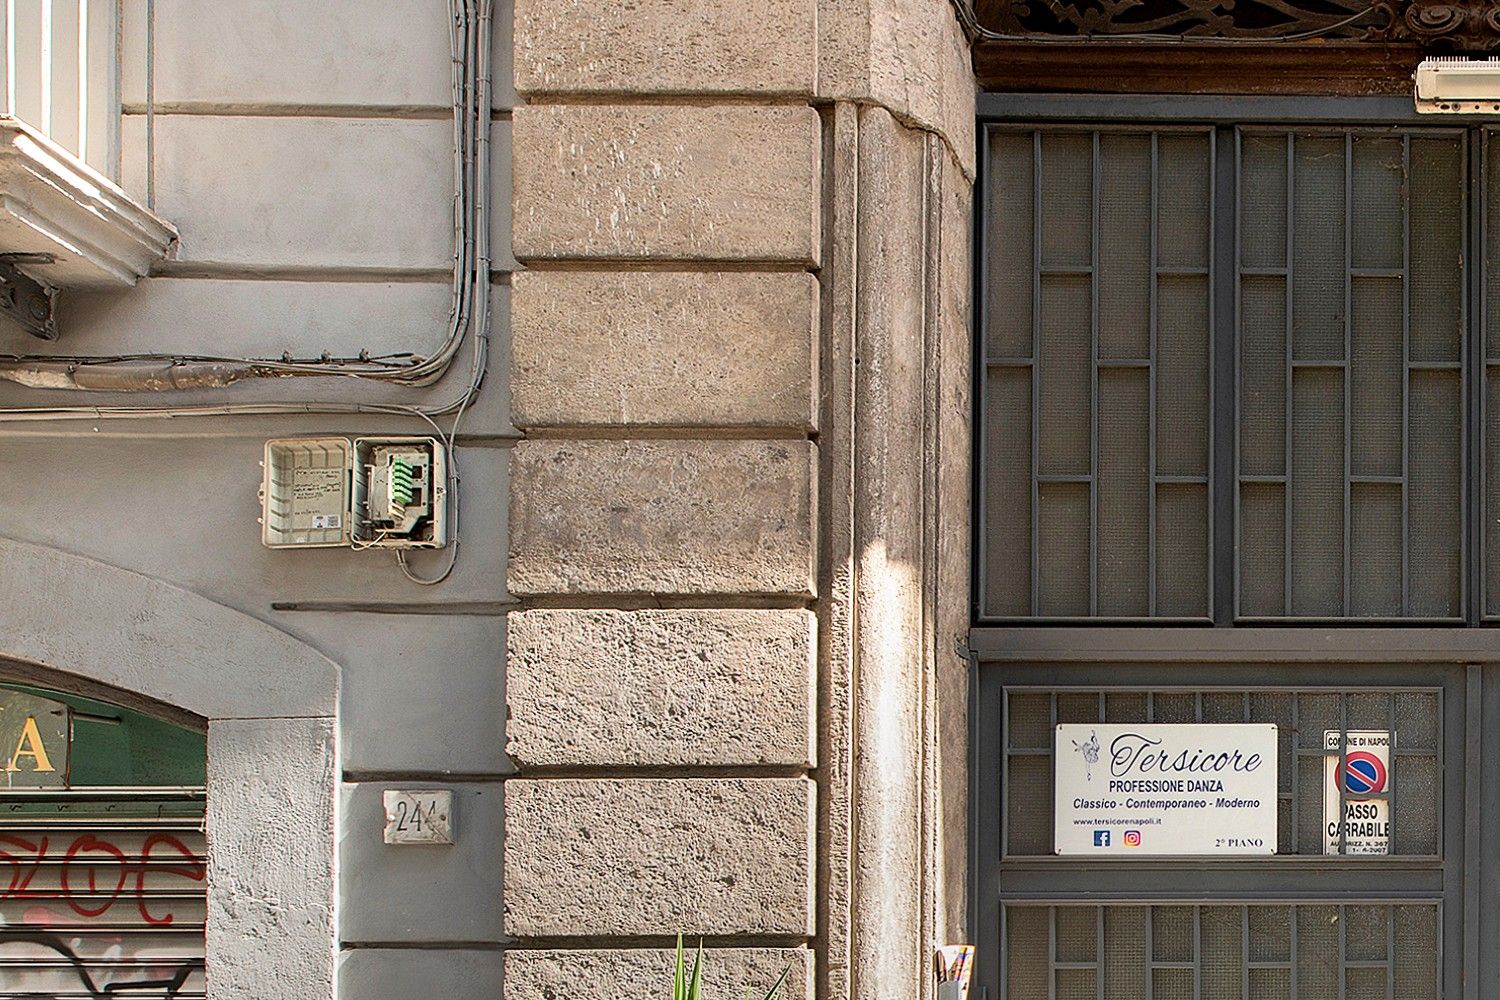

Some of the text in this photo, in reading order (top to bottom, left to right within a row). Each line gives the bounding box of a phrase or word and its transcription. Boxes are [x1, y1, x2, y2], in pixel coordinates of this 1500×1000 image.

[0, 709, 56, 772] A
[1359, 737, 1366, 746] DI
[1110, 733, 1262, 777] Tersicore
[1109, 780, 1223, 792] PROFESSIONE DANZA
[1073, 798, 1117, 809] Classico
[1126, 798, 1206, 811] Contemporaneo
[1215, 798, 1260, 808] Moderno
[1073, 818, 1162, 826] www.tersicorenapoli.it
[1228, 838, 1263, 847] PIANO
